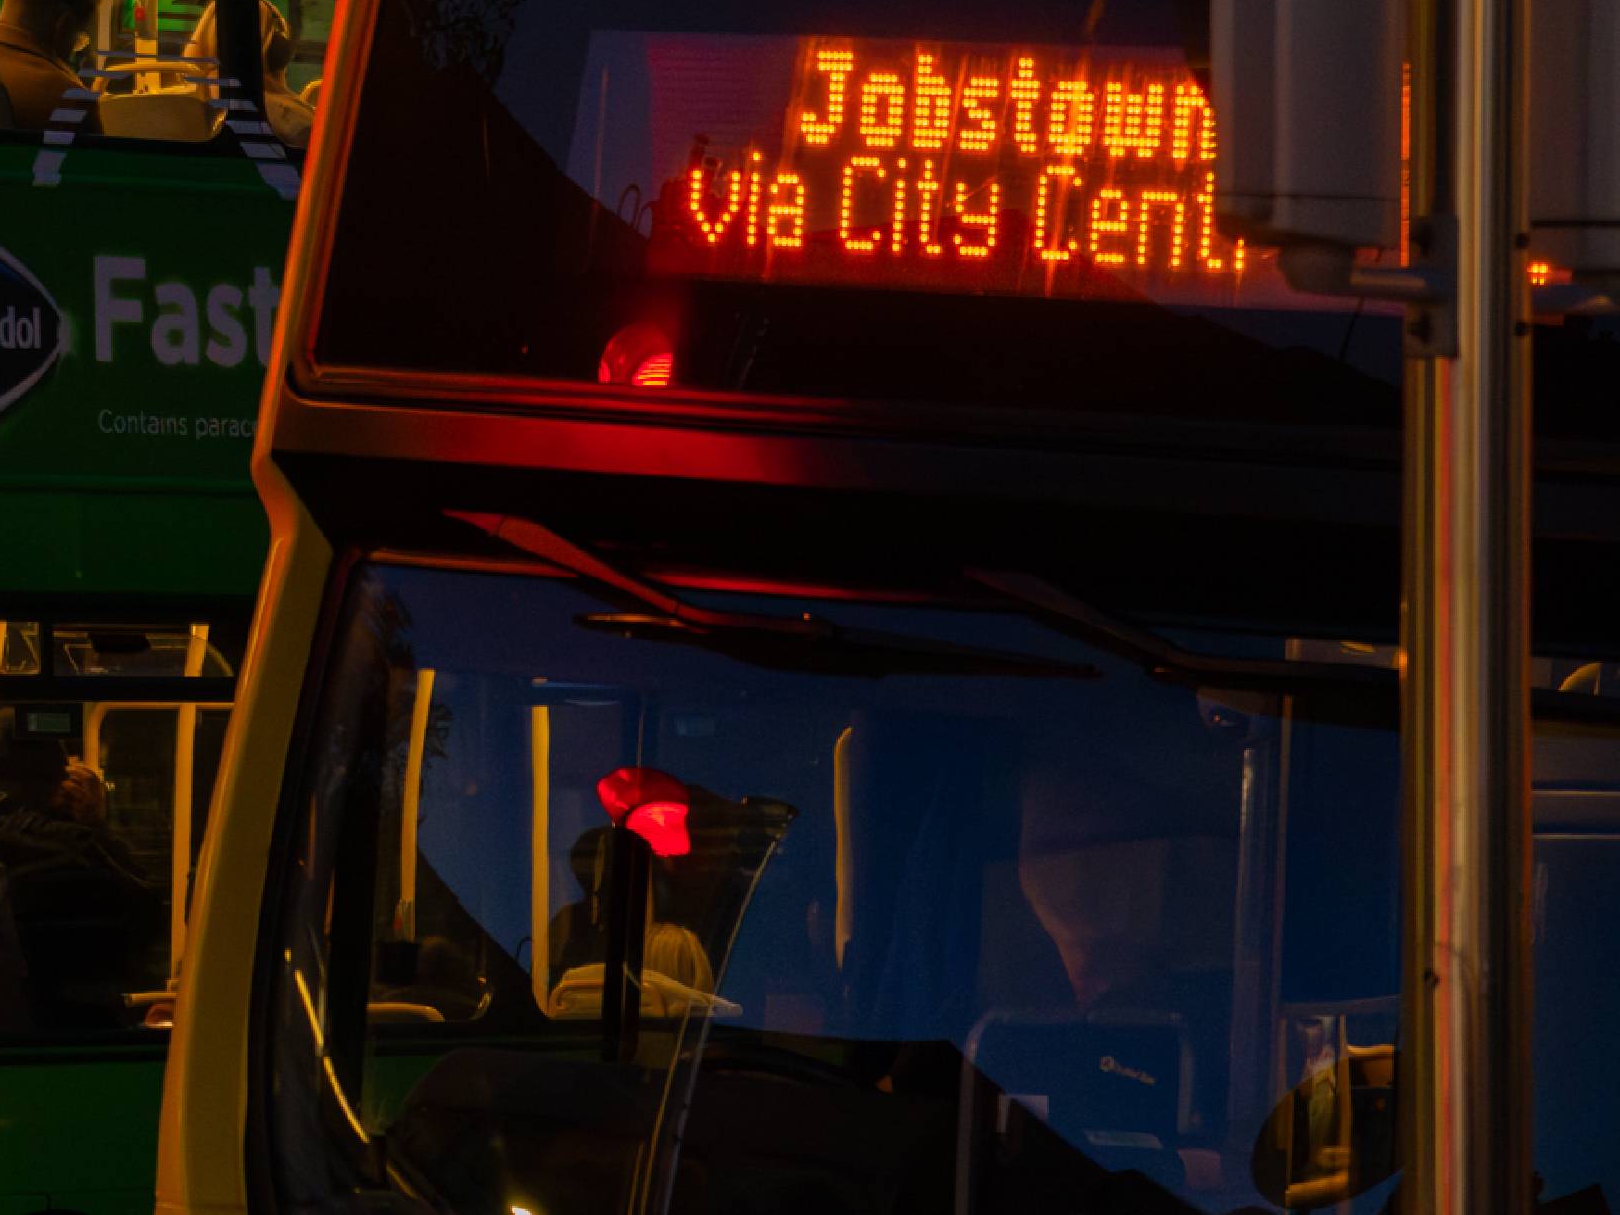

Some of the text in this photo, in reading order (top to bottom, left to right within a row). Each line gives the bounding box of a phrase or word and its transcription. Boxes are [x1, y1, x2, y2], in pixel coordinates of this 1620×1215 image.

[799, 49, 1217, 160] Jobstown
[689, 149, 1246, 272] via City Cent
[94, 256, 279, 367] Fast
[98, 408, 188, 436] Contains
